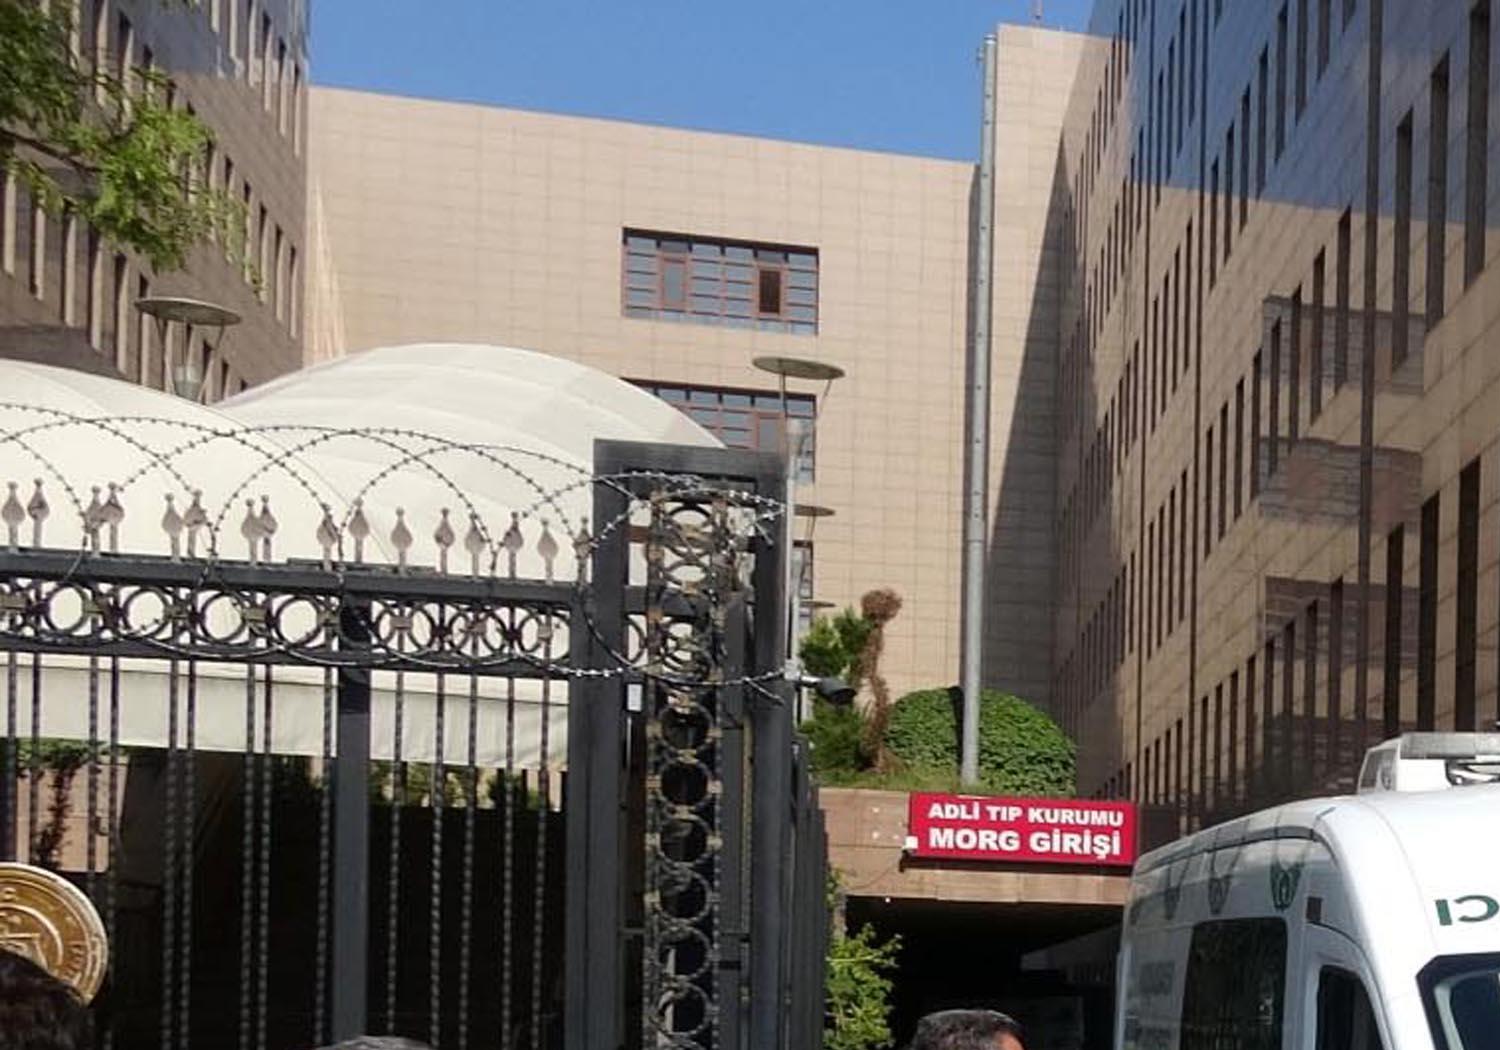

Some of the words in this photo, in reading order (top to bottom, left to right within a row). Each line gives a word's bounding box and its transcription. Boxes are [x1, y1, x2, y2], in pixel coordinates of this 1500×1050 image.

[928, 801, 980, 820] ADLİ
[986, 806, 1023, 822] TIP
[1028, 808, 1124, 827] KURUMU
[929, 828, 1020, 850] MORG
[1029, 829, 1121, 860] GİRİŞİ
